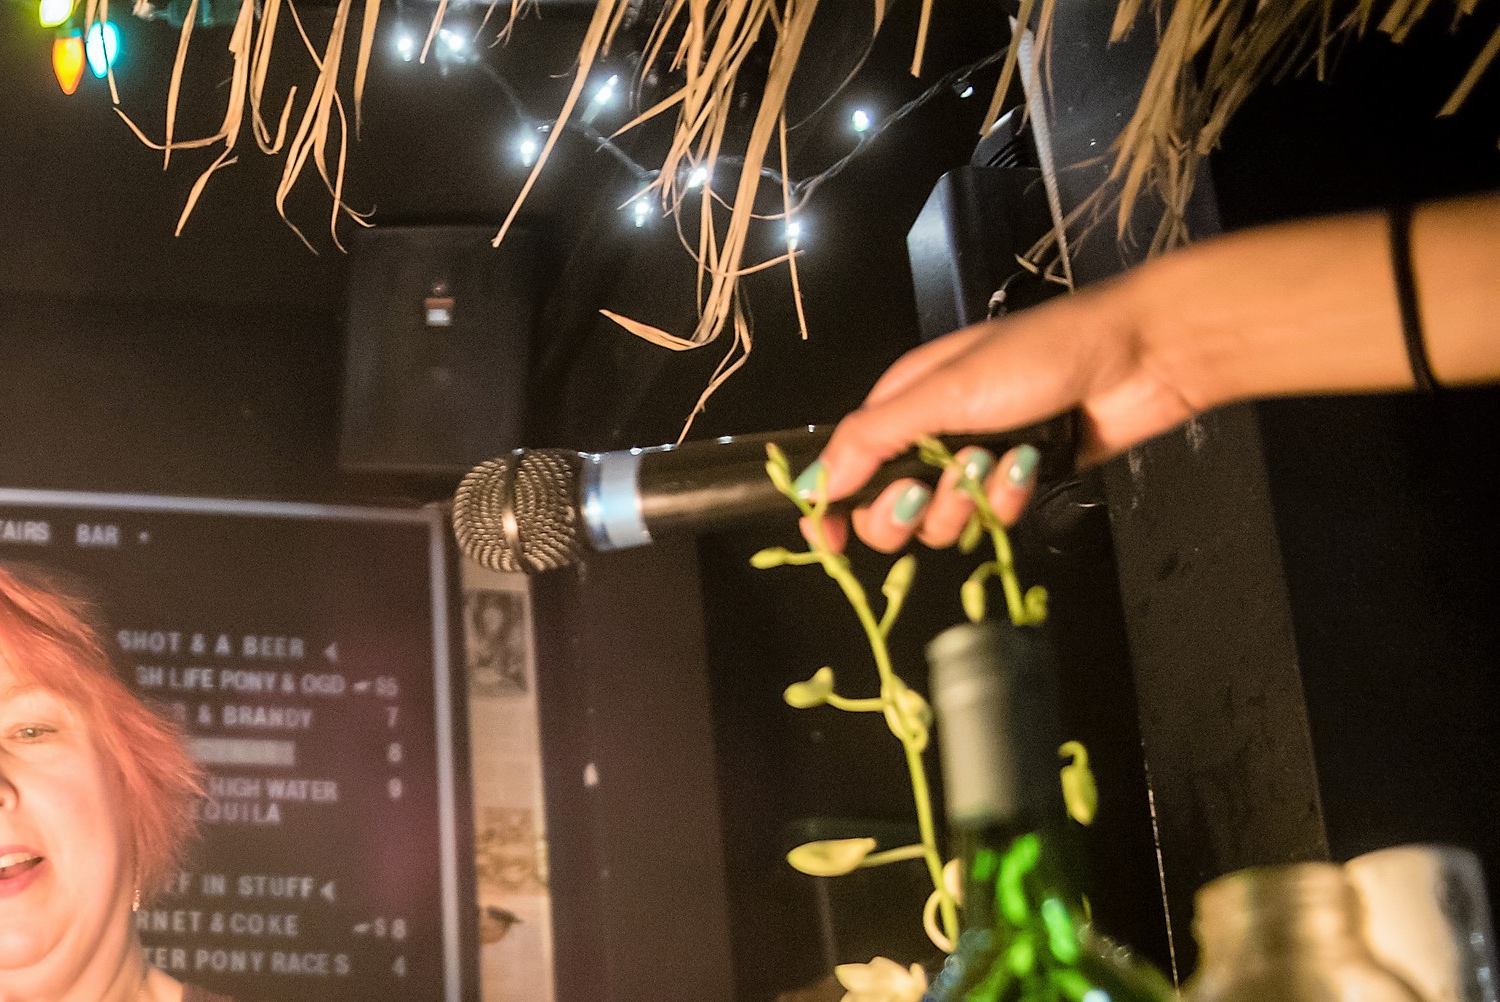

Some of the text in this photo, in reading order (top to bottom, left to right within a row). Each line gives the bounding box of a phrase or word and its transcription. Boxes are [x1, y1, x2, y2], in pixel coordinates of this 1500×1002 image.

[75, 523, 119, 545] BAR
[117, 630, 305, 658] SHOT & A BEER
[136, 666, 346, 696] GH LIFE PONY & OGD
[198, 705, 211, 726] &
[223, 705, 313, 728] BRANDY
[387, 707, 398, 728] 7
[209, 777, 338, 801] HIGH WATER
[189, 801, 281, 824] EQUILA
[203, 875, 225, 895] IN
[238, 876, 314, 897] STUFF
[136, 911, 299, 936] RNET & COKE
[142, 948, 350, 975] TER PONY RACES
[393, 955, 405, 976] 4
